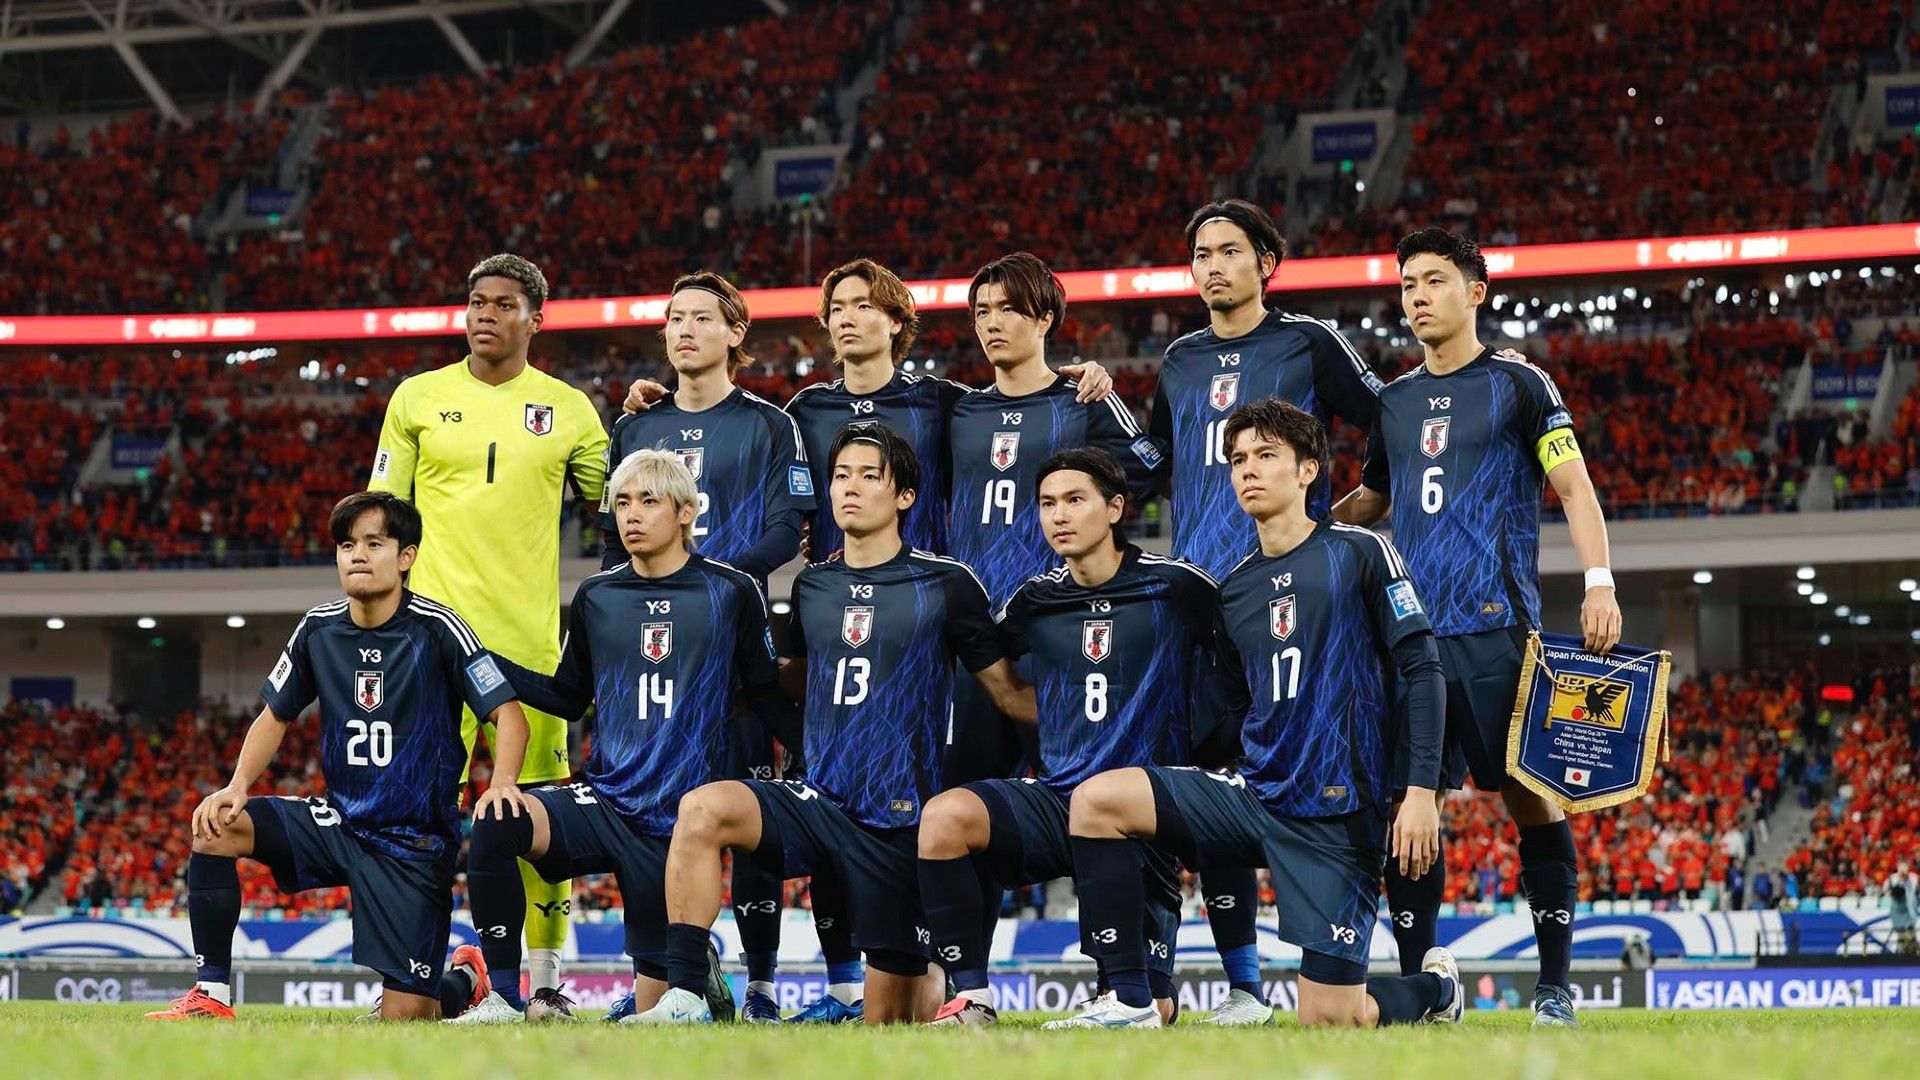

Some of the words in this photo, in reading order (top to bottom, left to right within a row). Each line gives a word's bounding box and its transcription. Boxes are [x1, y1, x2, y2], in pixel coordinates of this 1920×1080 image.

[1218, 353, 1241, 367] Y-3
[849, 399, 875, 416] Y-3
[1429, 397, 1451, 411] Y-3
[439, 411, 462, 423] Y-3
[1002, 412, 1022, 425] Y-3
[680, 428, 704, 441] Y-3
[486, 441, 497, 484] 1
[1421, 466, 1444, 514] 6
[981, 479, 1016, 525] 19
[1271, 572, 1292, 590] Y-3
[849, 584, 874, 599] Y-3
[645, 600, 671, 615] Y-3
[1085, 599, 1111, 613] Y-3
[358, 648, 382, 663] Y-3
[1546, 649, 1569, 660] Japan
[1571, 652, 1603, 665] Football
[833, 657, 871, 706] 13
[1271, 646, 1302, 703] 17
[638, 672, 674, 720] 14
[1085, 672, 1108, 722] 8
[346, 719, 393, 767] 20
[1554, 737, 1575, 748] China
[1577, 742, 1587, 750] vs.
[1590, 744, 1612, 755] Japan
[533, 899, 571, 918] Y-3
[734, 900, 777, 918] Y-3
[1205, 894, 1236, 910] -3
[1392, 911, 1415, 929] -3
[1533, 908, 1572, 926] Y-3
[1092, 927, 1118, 944] -3
[1330, 923, 1356, 945] Y-3
[938, 945, 962, 963] -3
[1148, 939, 1168, 960] Y-3
[409, 958, 432, 979] Y-3
[1671, 980, 1775, 1009] ASIAN
